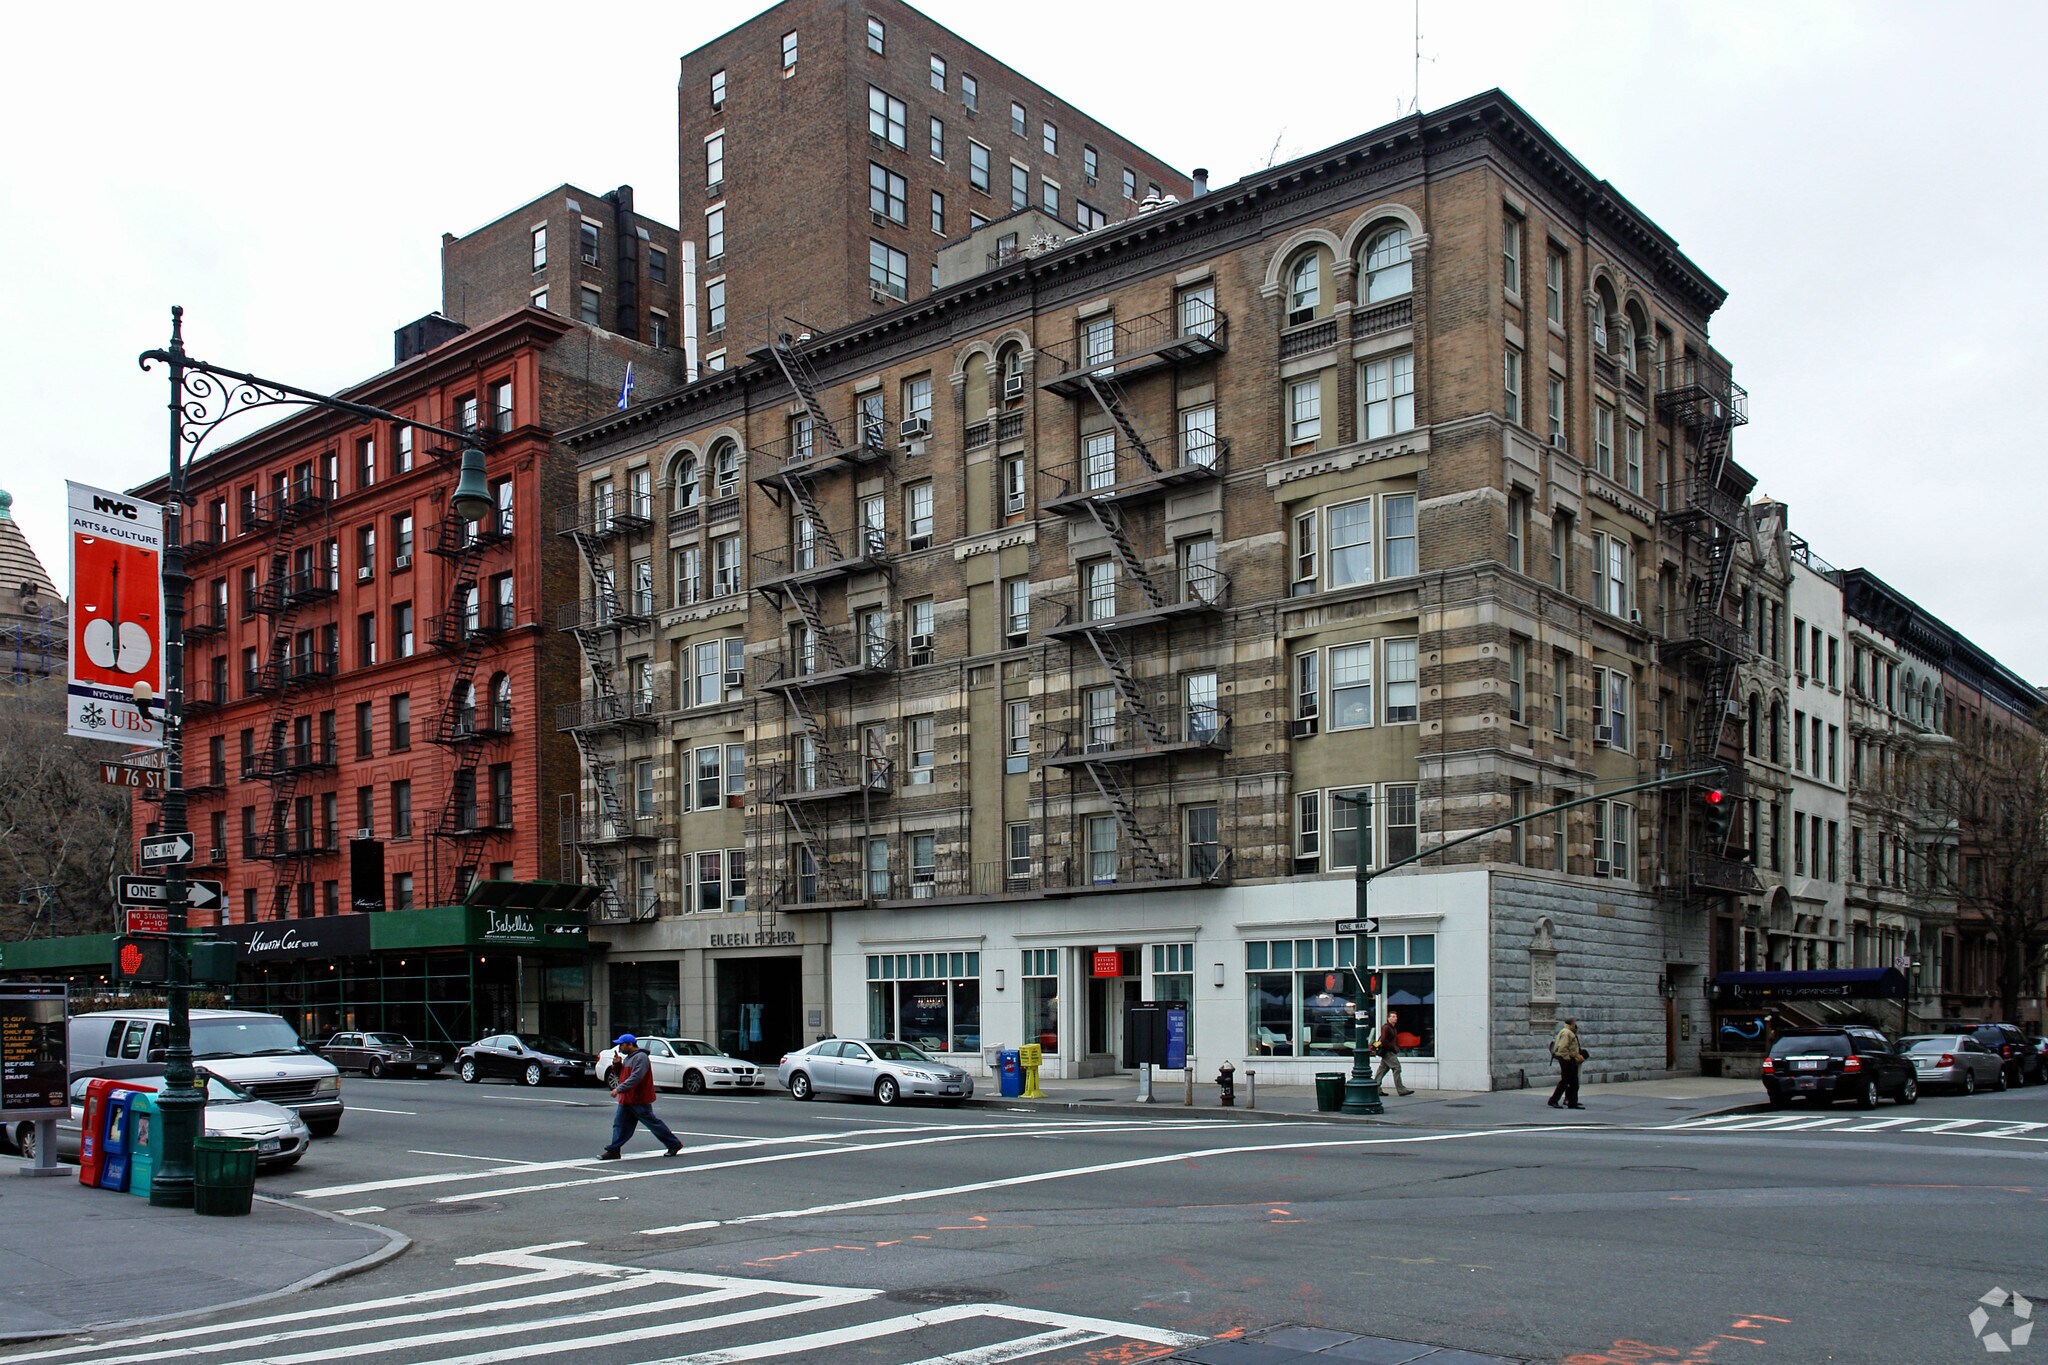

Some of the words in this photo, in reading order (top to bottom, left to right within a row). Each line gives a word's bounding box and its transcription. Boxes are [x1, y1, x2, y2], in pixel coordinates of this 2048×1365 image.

[93, 495, 138, 520] NYC
[73, 518, 101, 531] ARTS
[101, 525, 109, 533] &
[109, 527, 159, 545] CULTURE
[92, 690, 135, 702] NYCvisit.co
[110, 708, 153, 733] UBS
[105, 765, 118, 784] W
[124, 768, 140, 786] 76
[146, 770, 162, 789] ST
[145, 846, 158, 858] ONE
[161, 843, 176, 856] WAY
[130, 885, 157, 898] ONE
[131, 912, 141, 920] NO
[144, 912, 168, 920] STANDI
[486, 909, 534, 935] Isabella's
[1340, 923, 1352, 931] ONE
[710, 932, 749, 947] EILEEN
[754, 930, 797, 945] FISHER
